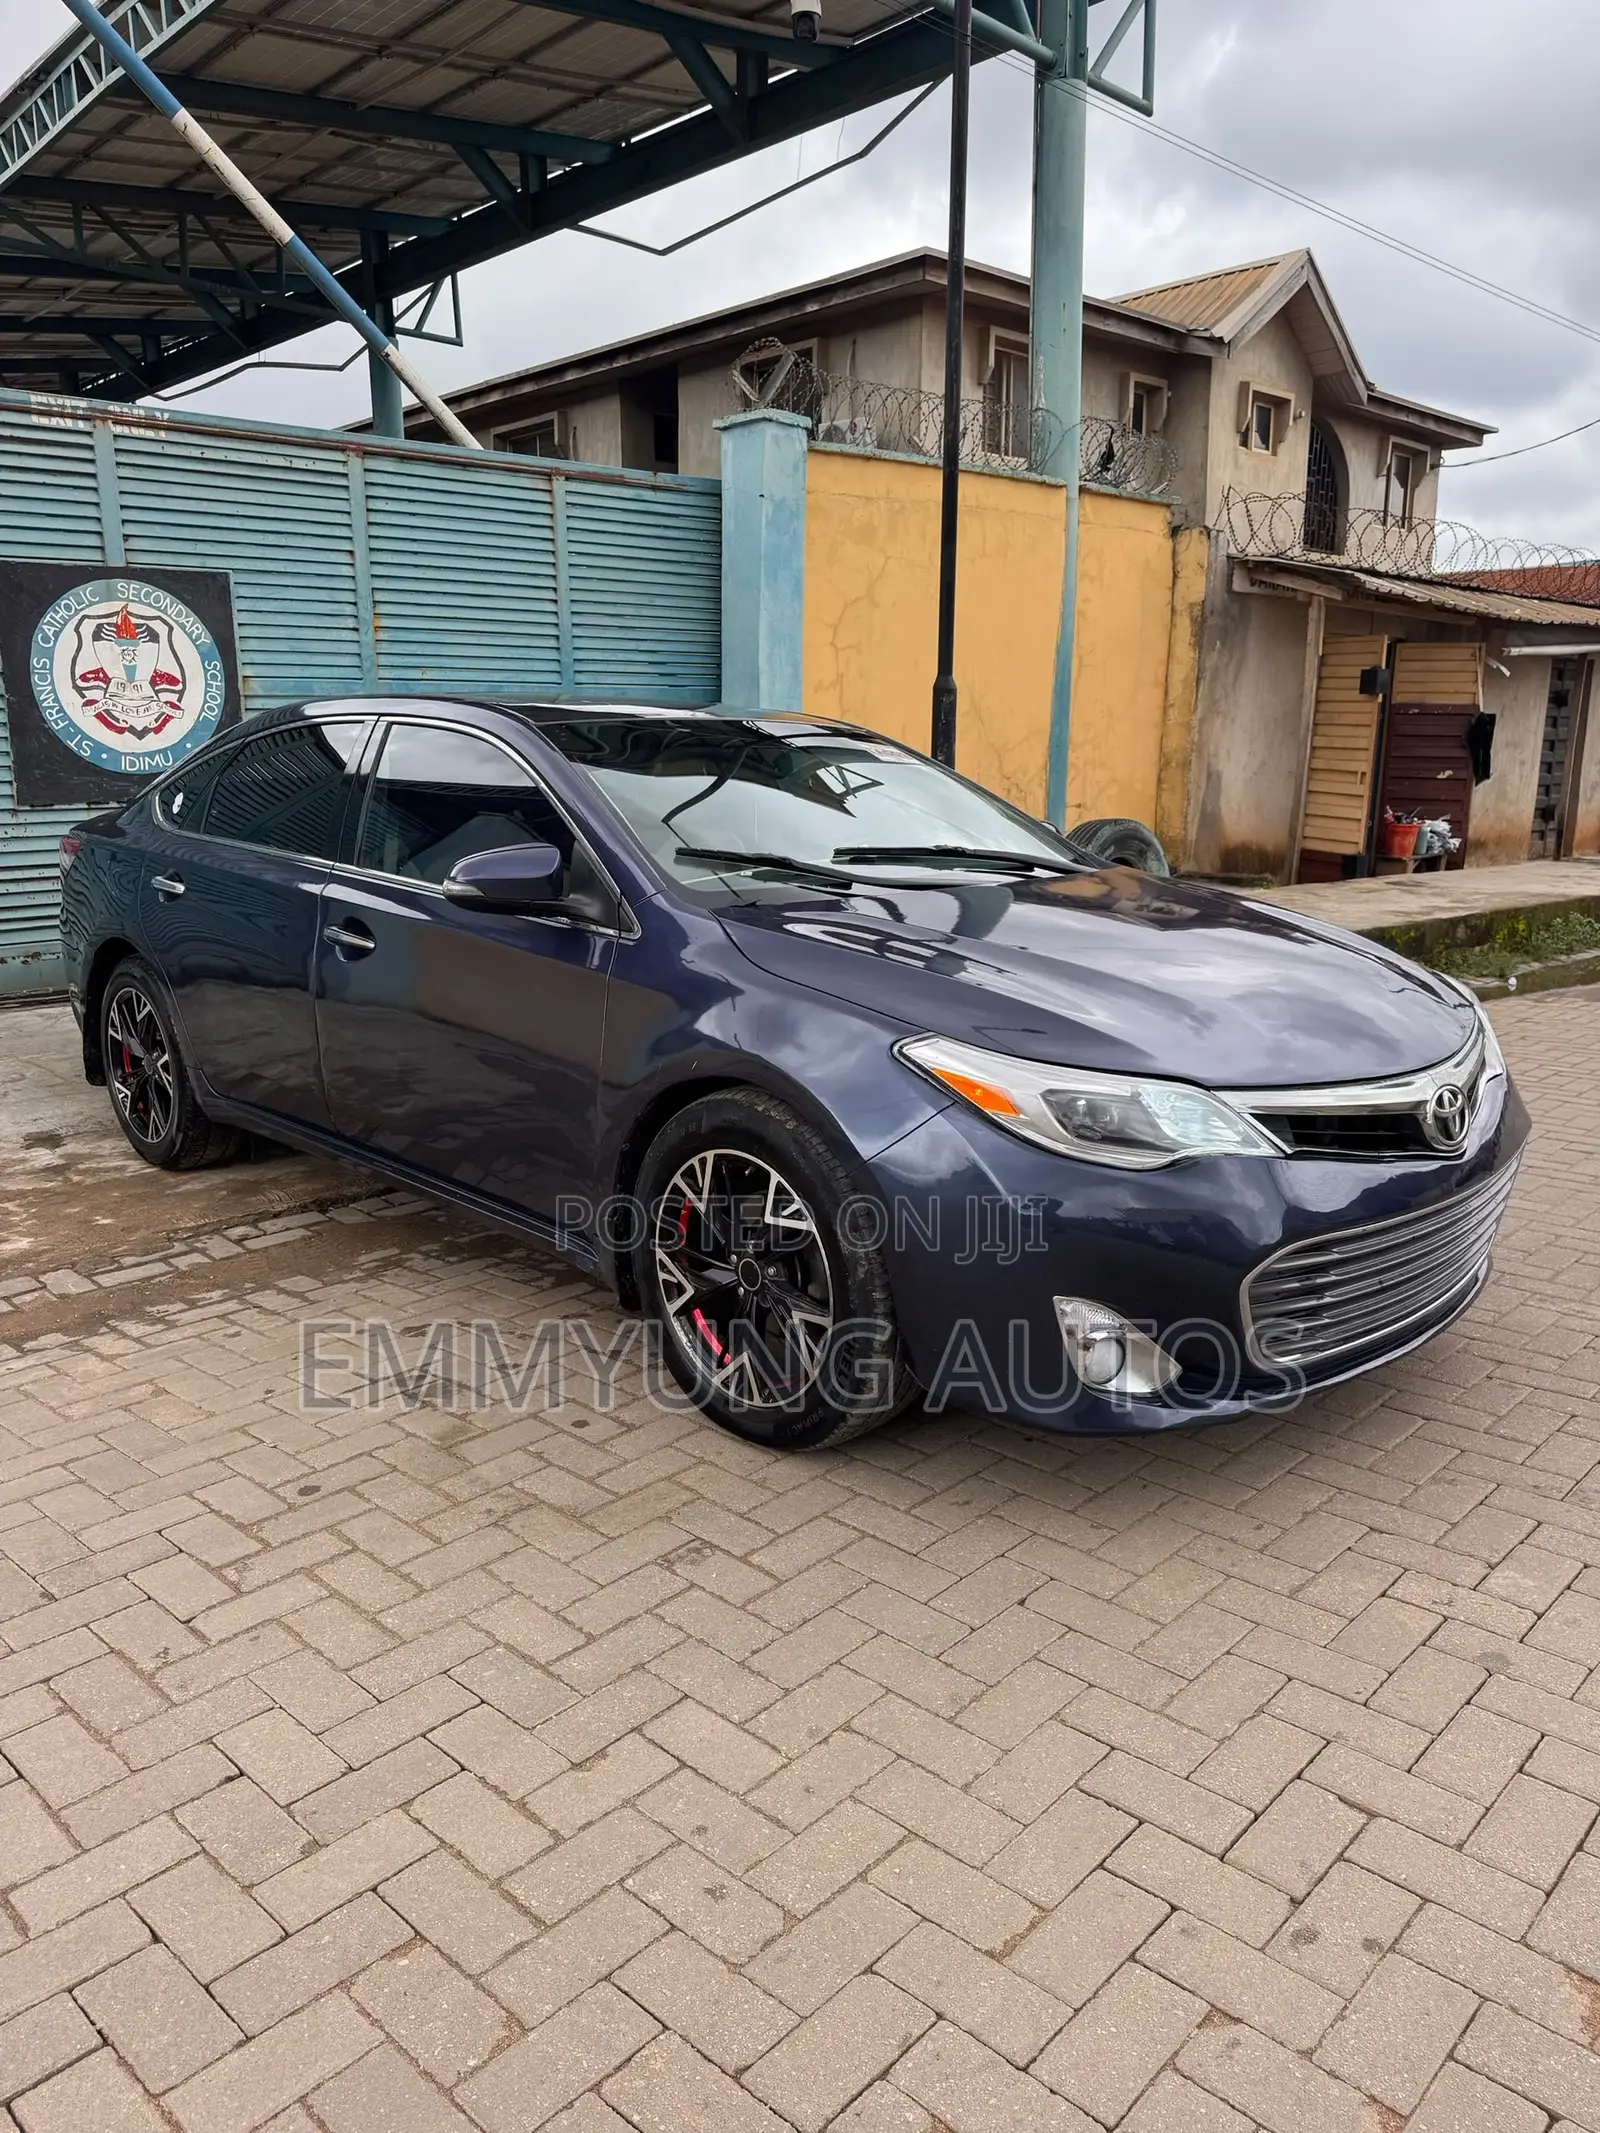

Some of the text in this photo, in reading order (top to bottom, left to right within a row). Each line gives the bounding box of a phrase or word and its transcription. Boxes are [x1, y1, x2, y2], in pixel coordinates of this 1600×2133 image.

[37, 587, 99, 648] CATHOLIC
[117, 582, 211, 646] SECONDARY
[199, 660, 221, 722] SCHOOL
[121, 751, 173, 772] IDIMU
